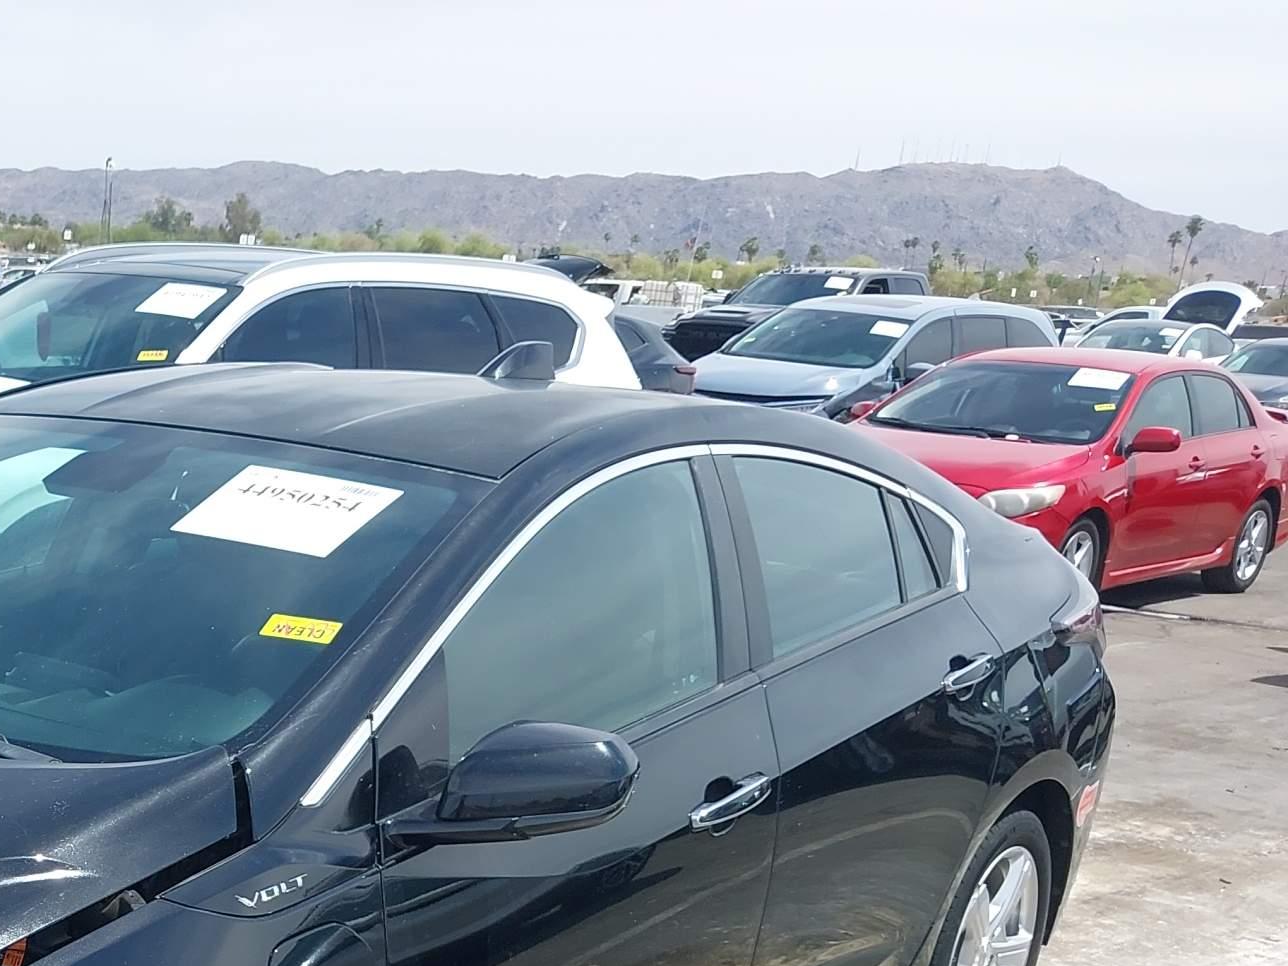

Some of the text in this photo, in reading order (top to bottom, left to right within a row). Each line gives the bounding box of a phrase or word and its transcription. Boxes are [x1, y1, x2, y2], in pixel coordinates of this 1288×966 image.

[237, 483, 363, 513] 44950254
[272, 622, 326, 639] CLEAN
[234, 873, 309, 909] VOLT
